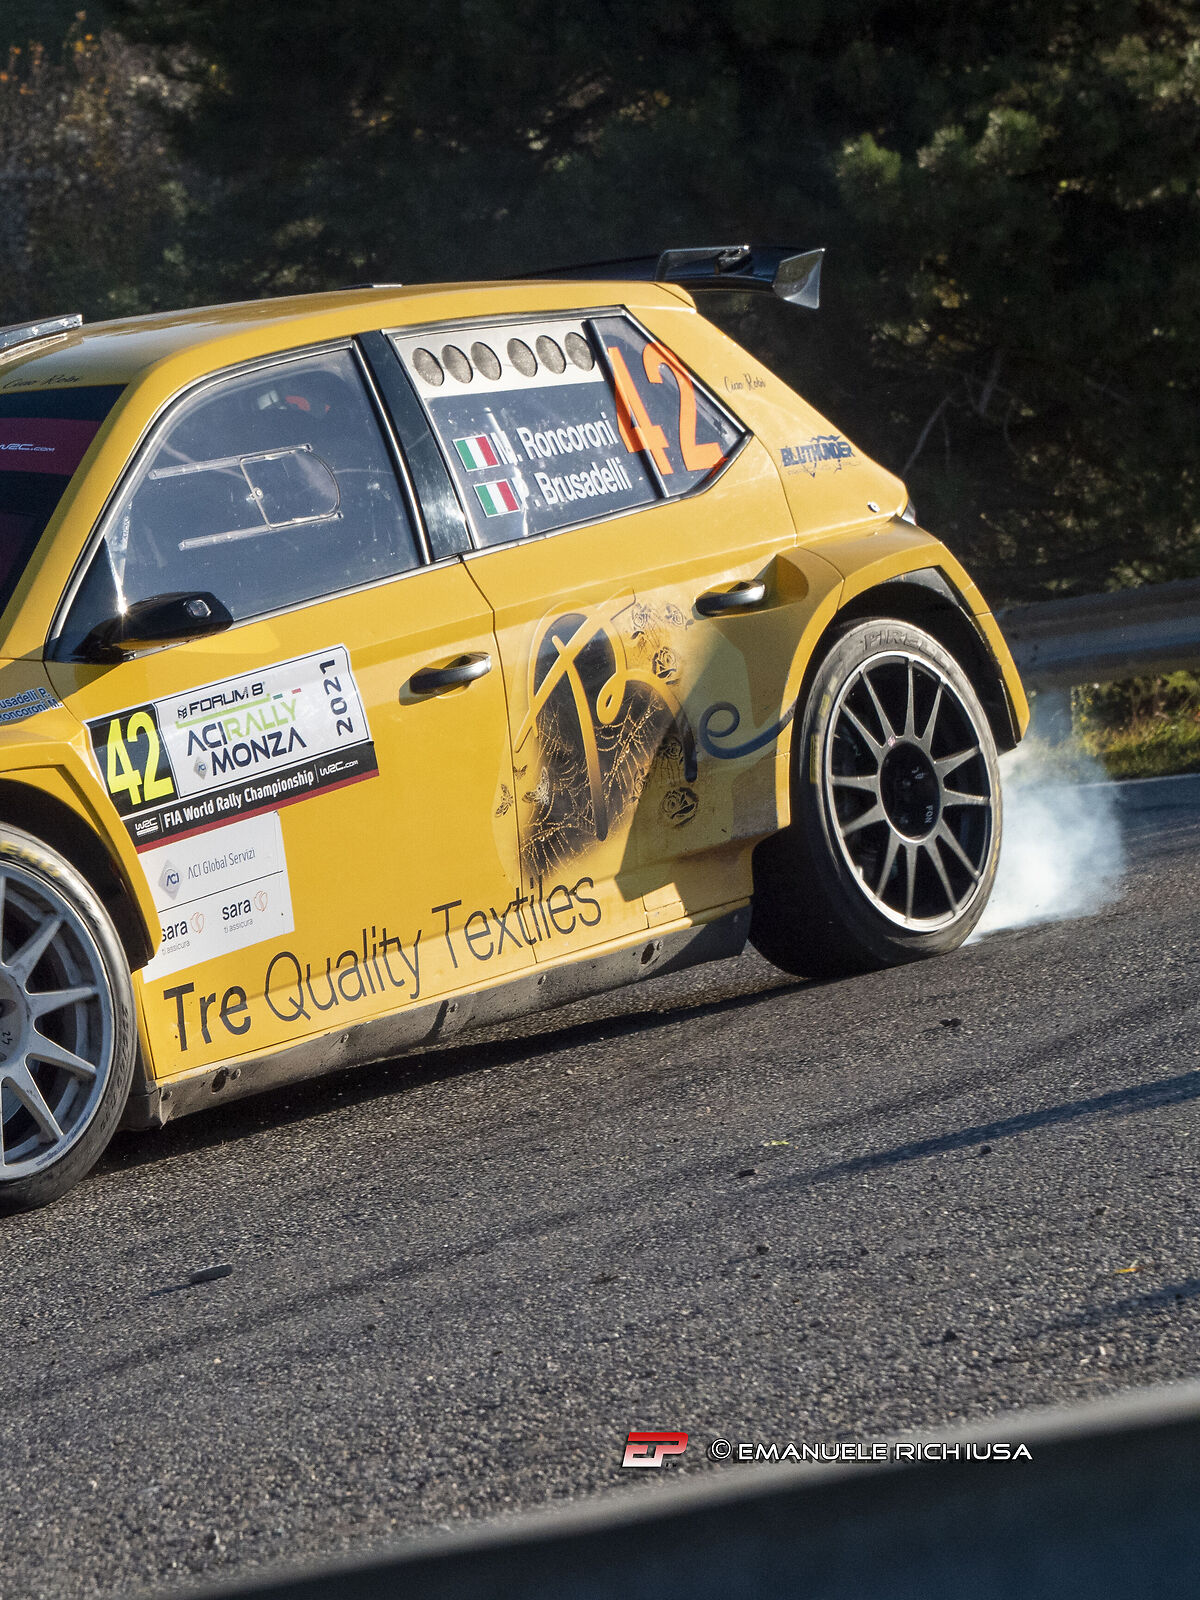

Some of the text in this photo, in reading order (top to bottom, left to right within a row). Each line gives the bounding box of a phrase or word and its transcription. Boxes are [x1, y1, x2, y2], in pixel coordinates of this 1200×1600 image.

[607, 341, 728, 475] 42
[515, 412, 619, 460] Roncoroni
[534, 456, 632, 505] Brusadelli
[38, 687, 51, 698] P.
[188, 682, 264, 716] FORUM 8
[319, 658, 354, 737] 2021
[106, 711, 175, 806] 42
[210, 727, 307, 777] MONZA
[163, 810, 183, 830] FIA
[183, 799, 215, 822] World
[216, 791, 243, 812] Rally
[243, 770, 314, 803] Championship
[188, 863, 202, 880] ACI
[202, 855, 228, 875] Global
[228, 847, 256, 866] Servizi
[161, 920, 189, 942] sara
[221, 899, 252, 921] sara
[162, 875, 603, 1053] Tre Quality Textiles
